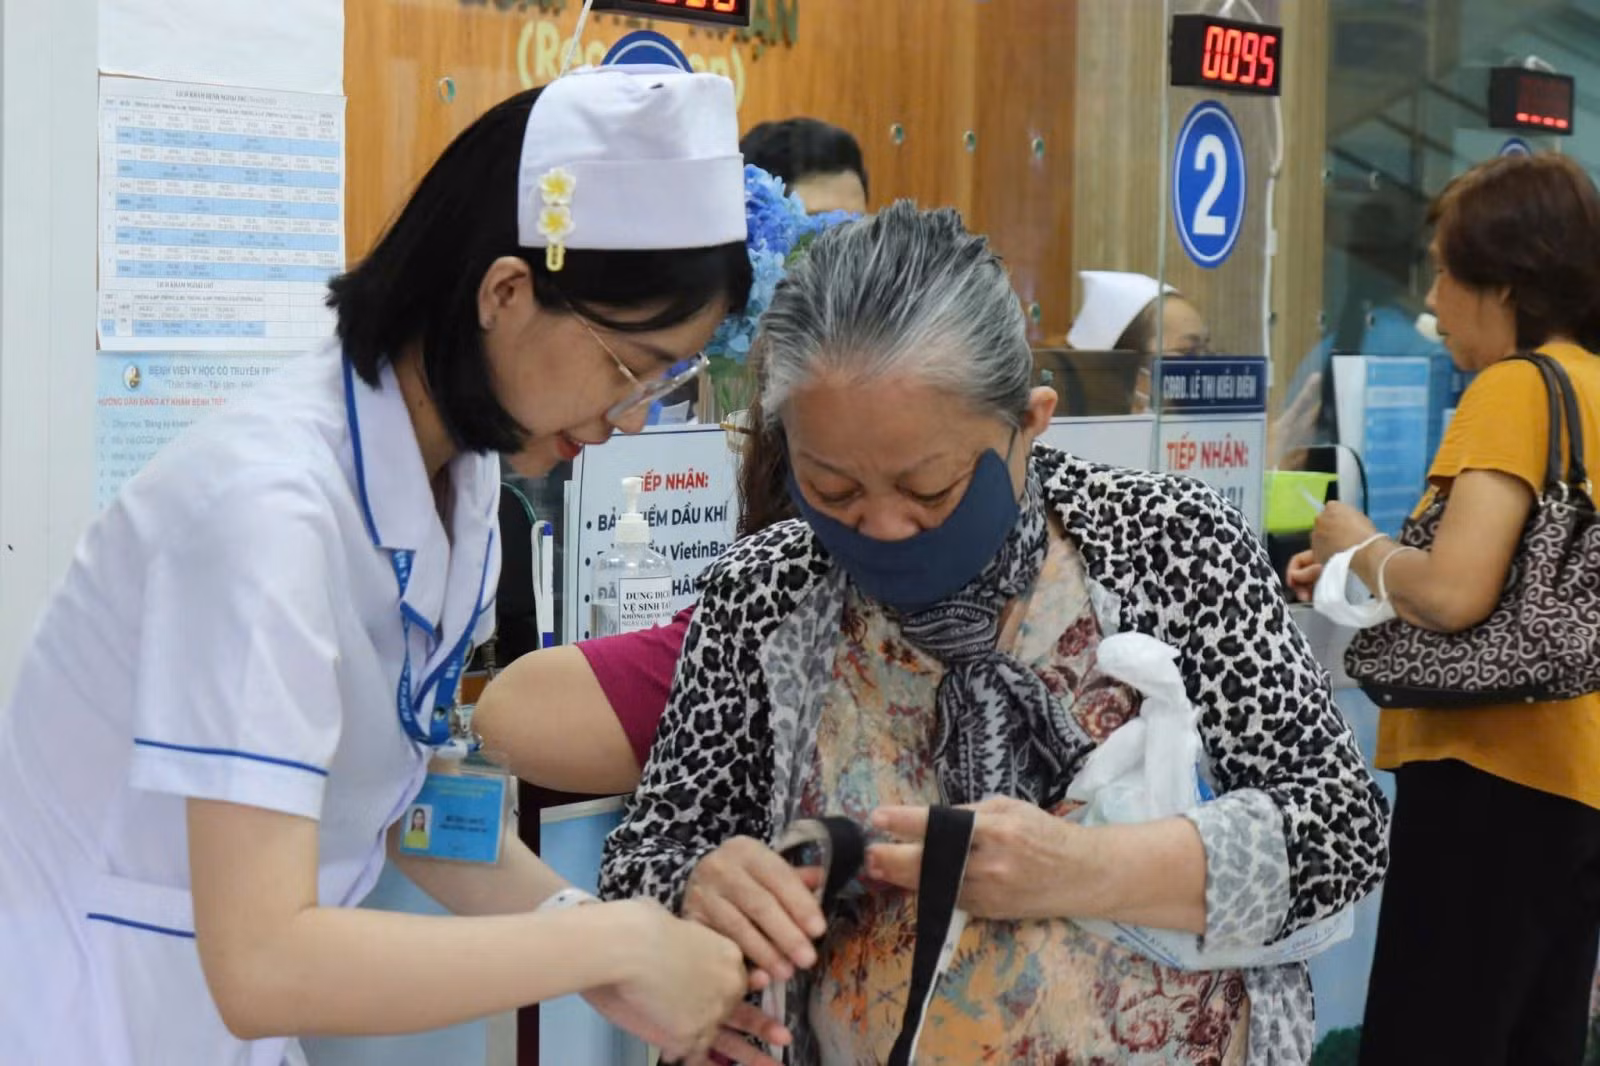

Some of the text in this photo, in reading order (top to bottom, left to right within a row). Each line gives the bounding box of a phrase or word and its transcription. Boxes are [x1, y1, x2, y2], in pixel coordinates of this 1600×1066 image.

[1202, 26, 1276, 87] 0095
[1191, 133, 1228, 237] 2
[1166, 431, 1249, 476] TIẾP NHẬN:
[666, 467, 709, 494] NHẬN:
[672, 501, 701, 526] DẦU
[705, 500, 729, 523] KHÍ
[625, 591, 654, 601] DUNG
[639, 602, 661, 611] SINH
